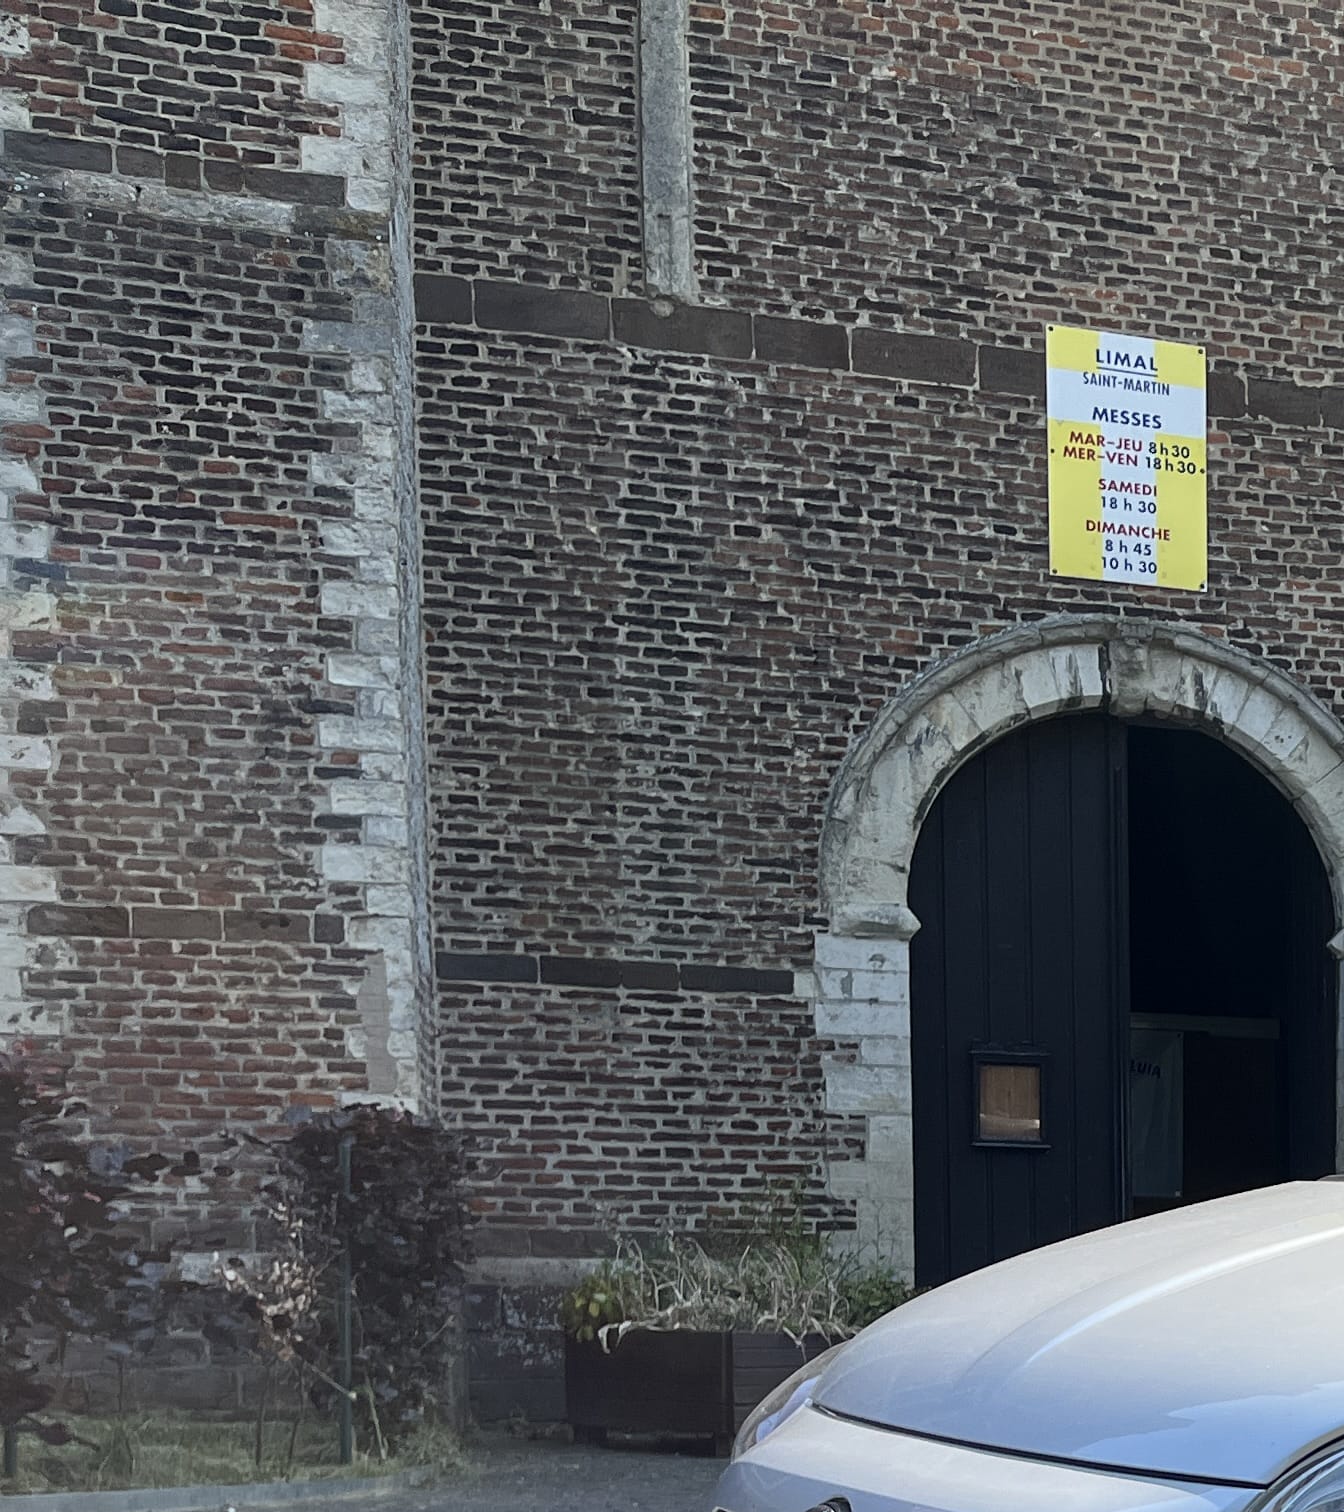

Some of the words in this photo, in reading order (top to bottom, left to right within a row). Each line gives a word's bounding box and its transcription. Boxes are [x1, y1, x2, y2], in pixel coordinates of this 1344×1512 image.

[1096, 349, 1158, 371] LIMAL
[1083, 371, 1170, 396] SAINT-MARTIN
[1092, 406, 1162, 429] MESSES
[1069, 431, 1142, 452] MAR-JEU
[1063, 446, 1138, 467] MER-VEN
[1098, 478, 1157, 497] SAMEDI
[1085, 519, 1171, 541] DIMANCHE
